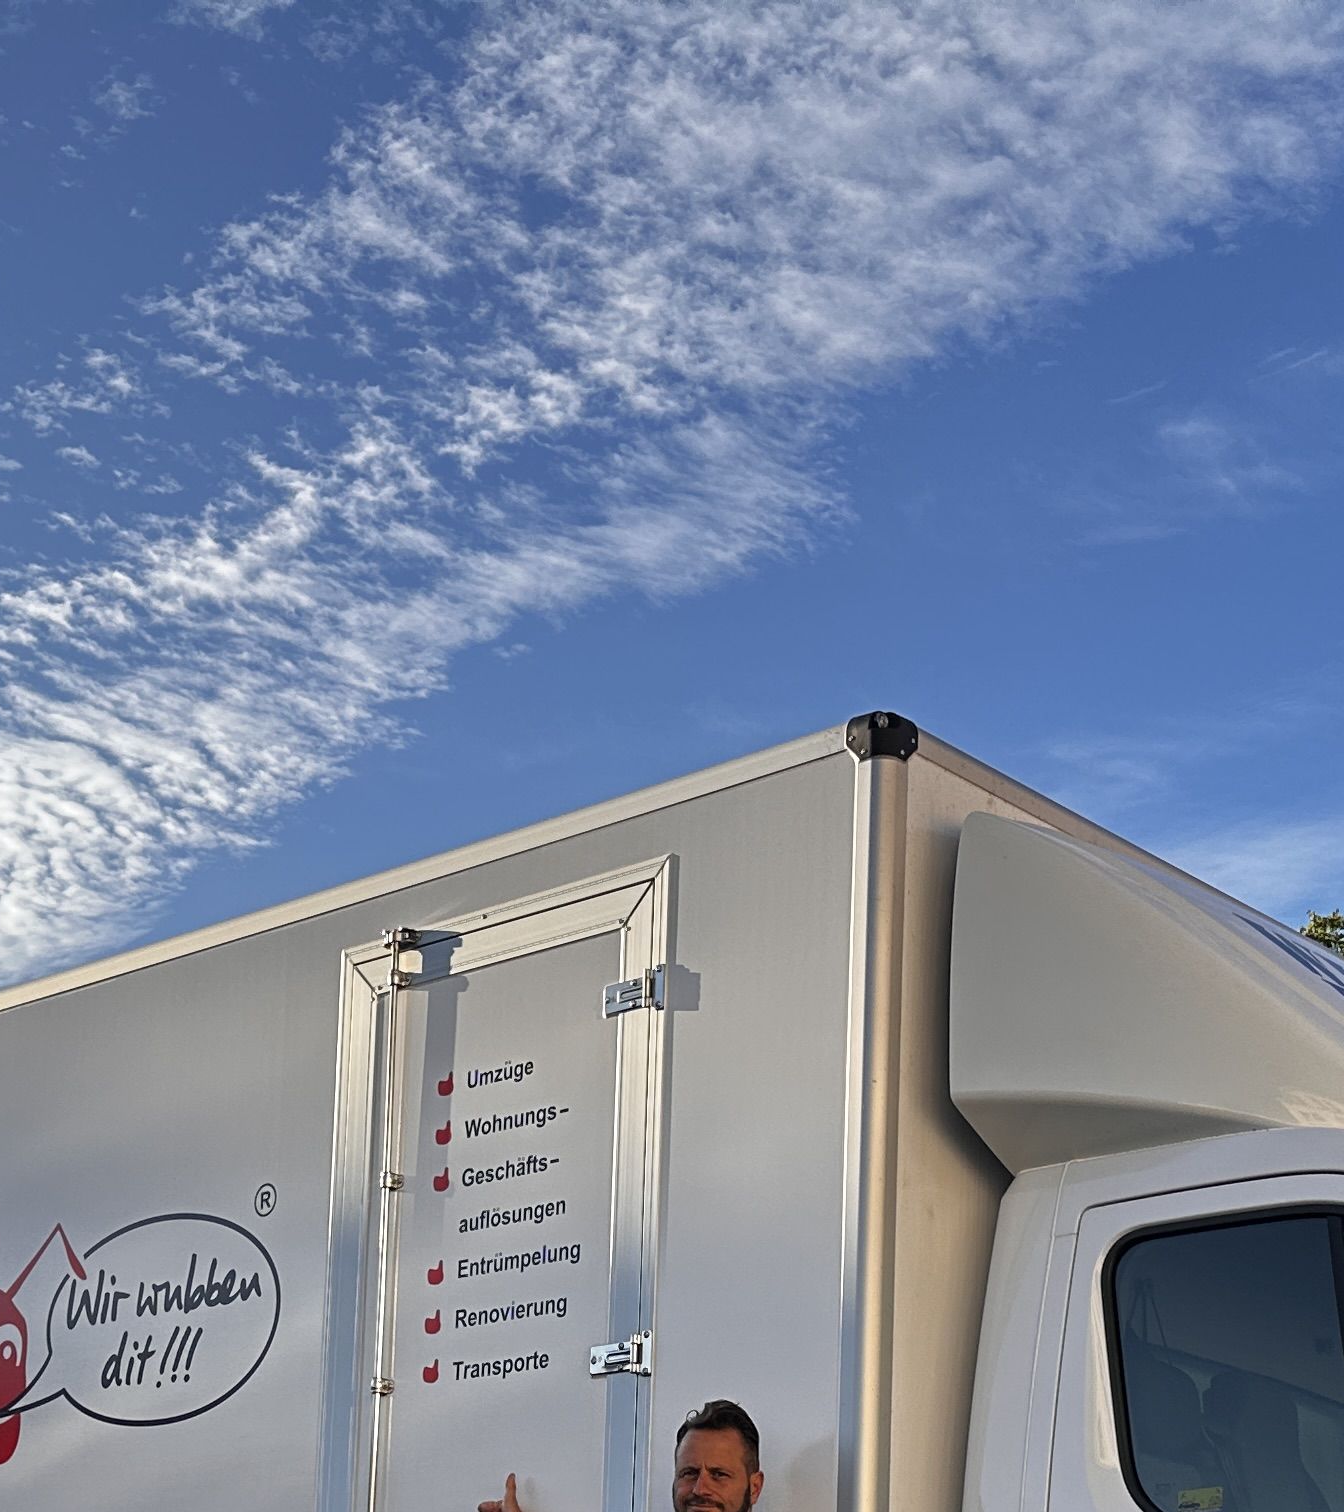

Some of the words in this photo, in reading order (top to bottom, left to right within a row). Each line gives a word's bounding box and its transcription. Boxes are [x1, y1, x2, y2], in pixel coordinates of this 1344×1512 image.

[467, 1059, 534, 1089] Umzüge
[458, 1199, 566, 1234] auflösungen
[457, 1242, 581, 1279] Entrümpelung
[66, 1268, 131, 1330] Wir
[136, 1253, 262, 1318] wubben
[455, 1296, 568, 1329] Renovierung
[100, 1326, 203, 1389] dit!!!
[452, 1350, 549, 1381] Transporte
